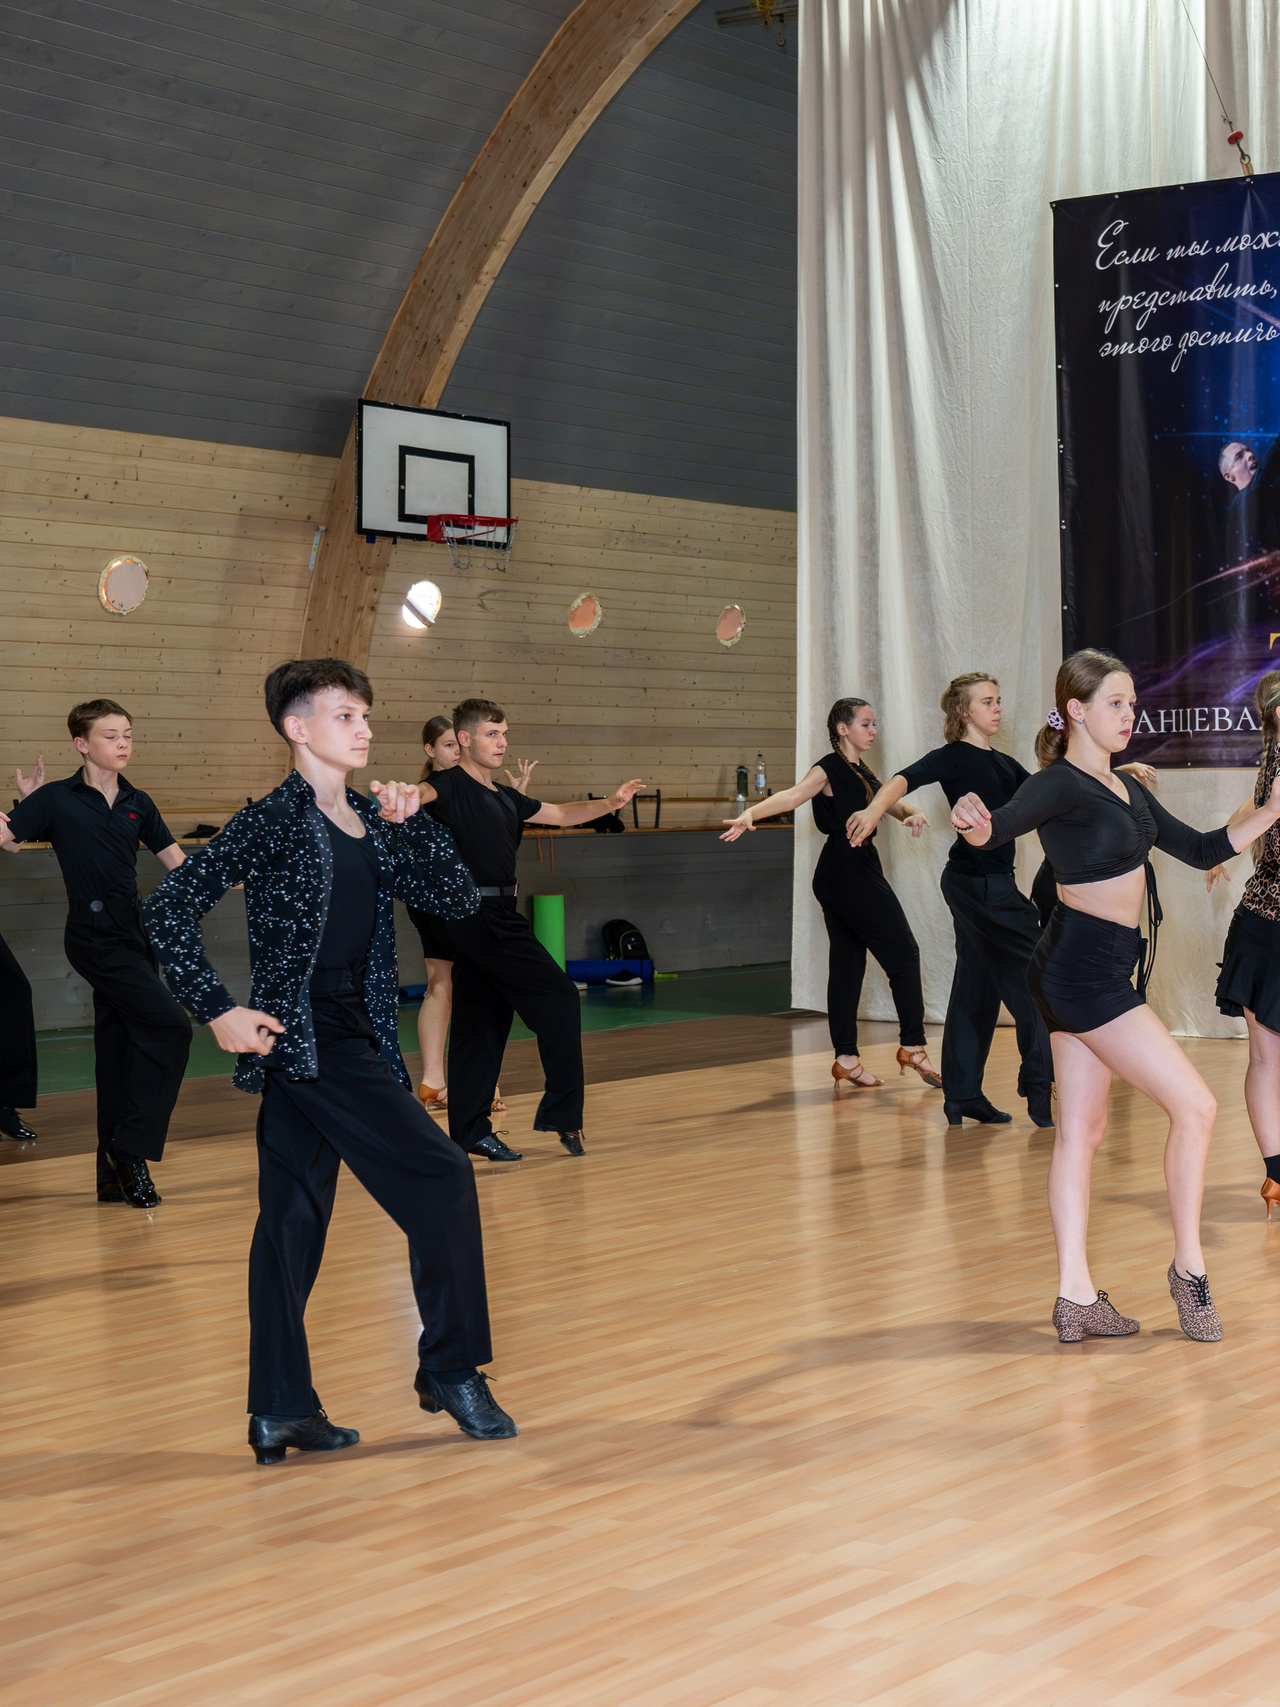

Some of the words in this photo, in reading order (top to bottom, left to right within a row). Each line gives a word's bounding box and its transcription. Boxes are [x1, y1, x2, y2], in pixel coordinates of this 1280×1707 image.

[1095, 219, 1160, 270] Если
[1166, 239, 1213, 261] ты
[1098, 261, 1277, 335] представить,
[1099, 334, 1174, 358] этого
[1171, 322, 1280, 373] достичь
